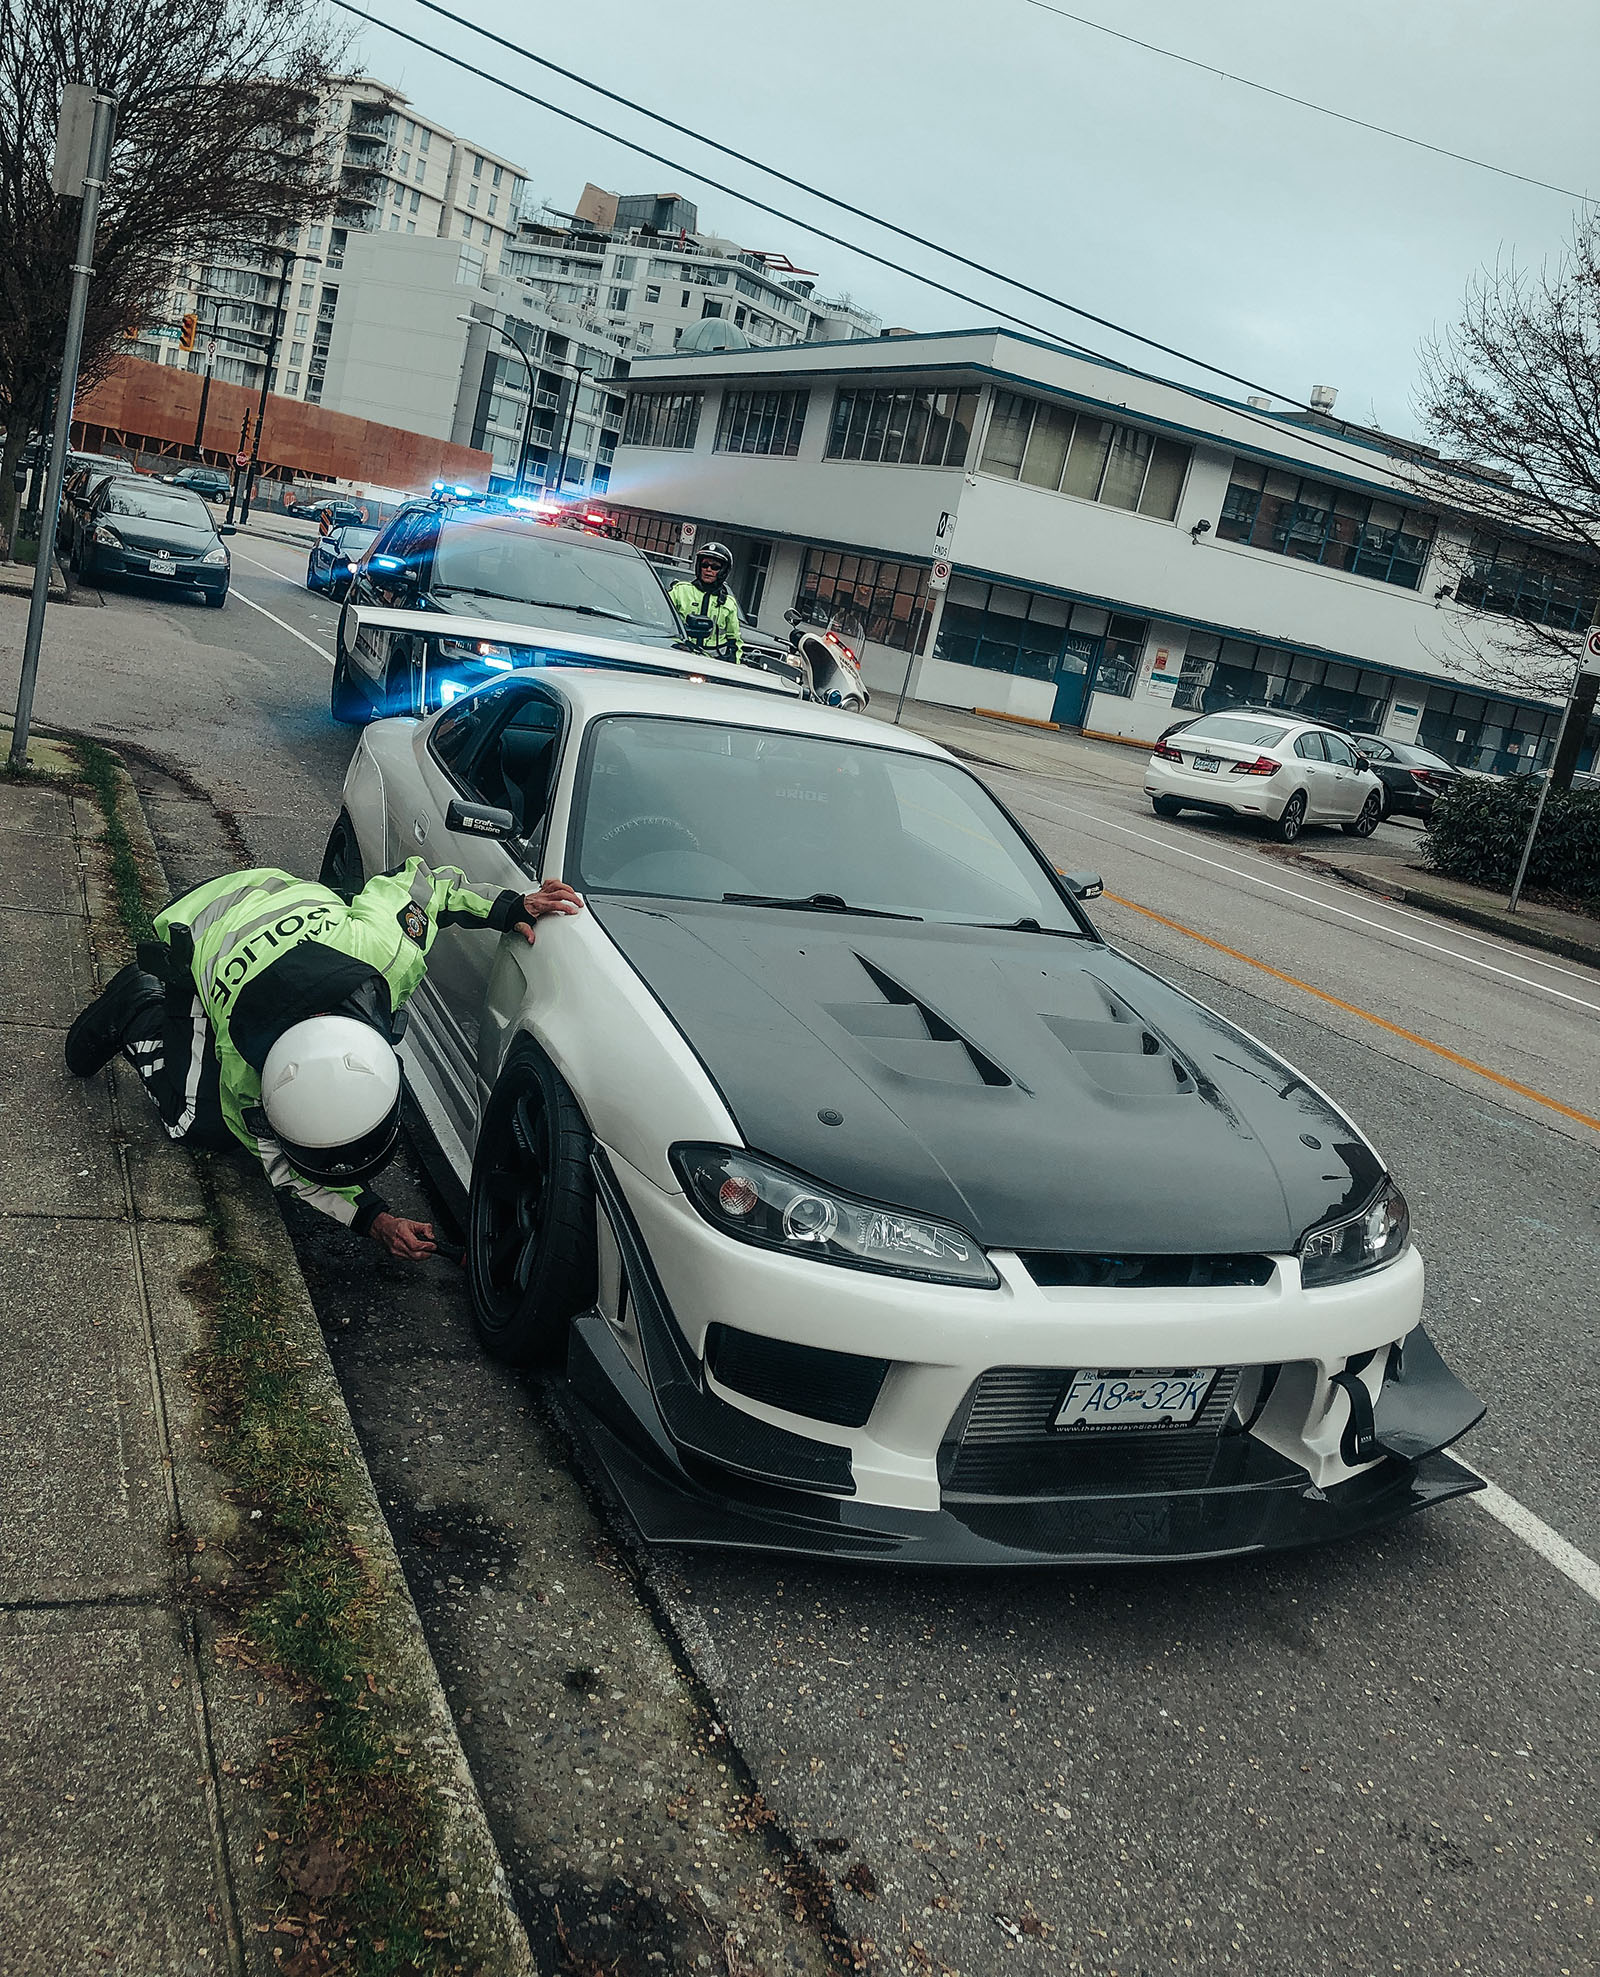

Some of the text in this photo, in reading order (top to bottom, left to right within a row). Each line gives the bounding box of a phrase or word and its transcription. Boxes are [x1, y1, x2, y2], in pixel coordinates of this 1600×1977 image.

[933, 544, 948, 557] ENDS
[473, 824, 501, 834] square
[210, 907, 331, 1012] POLICE
[1061, 1380, 1208, 1413] FA8 32K
[1056, 1423, 1188, 1432] www.thespeedsyndicate.com
